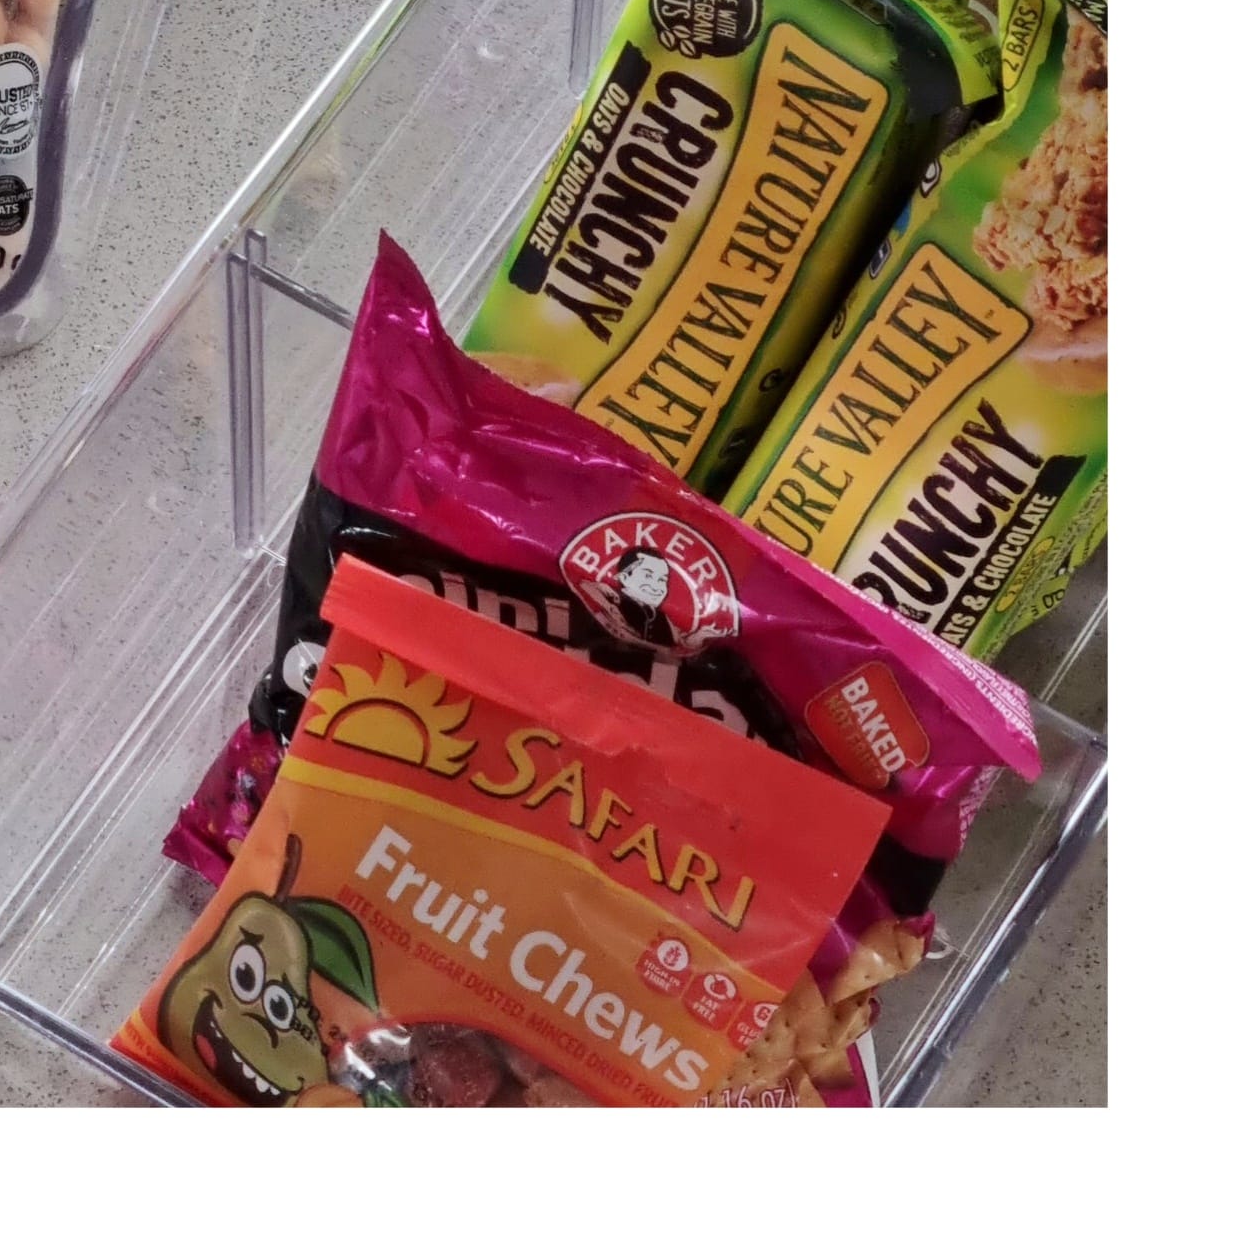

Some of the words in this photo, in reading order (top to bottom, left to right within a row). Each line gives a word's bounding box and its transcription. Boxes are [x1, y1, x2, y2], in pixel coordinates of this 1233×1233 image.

[717, 11, 736, 41] WITH
[1003, 59, 1020, 72] 2
[1007, 5, 1039, 56] BARS
[580, 130, 604, 153] &
[592, 81, 631, 135] OATS
[529, 150, 596, 257] CHOCOLATE
[543, 71, 734, 345] CRUNCHY
[719, 46, 871, 284] NATURE
[598, 279, 768, 468] VALLEY
[815, 260, 1001, 458] VALLEY
[571, 522, 728, 610] BAKER
[973, 492, 1057, 591] CHOCOLATE
[962, 594, 990, 616] &
[841, 676, 906, 773] BAKED
[470, 728, 756, 932] SAFARI
[338, 884, 371, 918] BITE
[414, 940, 465, 983] SUGAR
[525, 1012, 586, 1062] MINCED
[585, 1050, 632, 1089] DRIED
[355, 825, 507, 960] Fruit
[509, 929, 711, 1092] Chews
